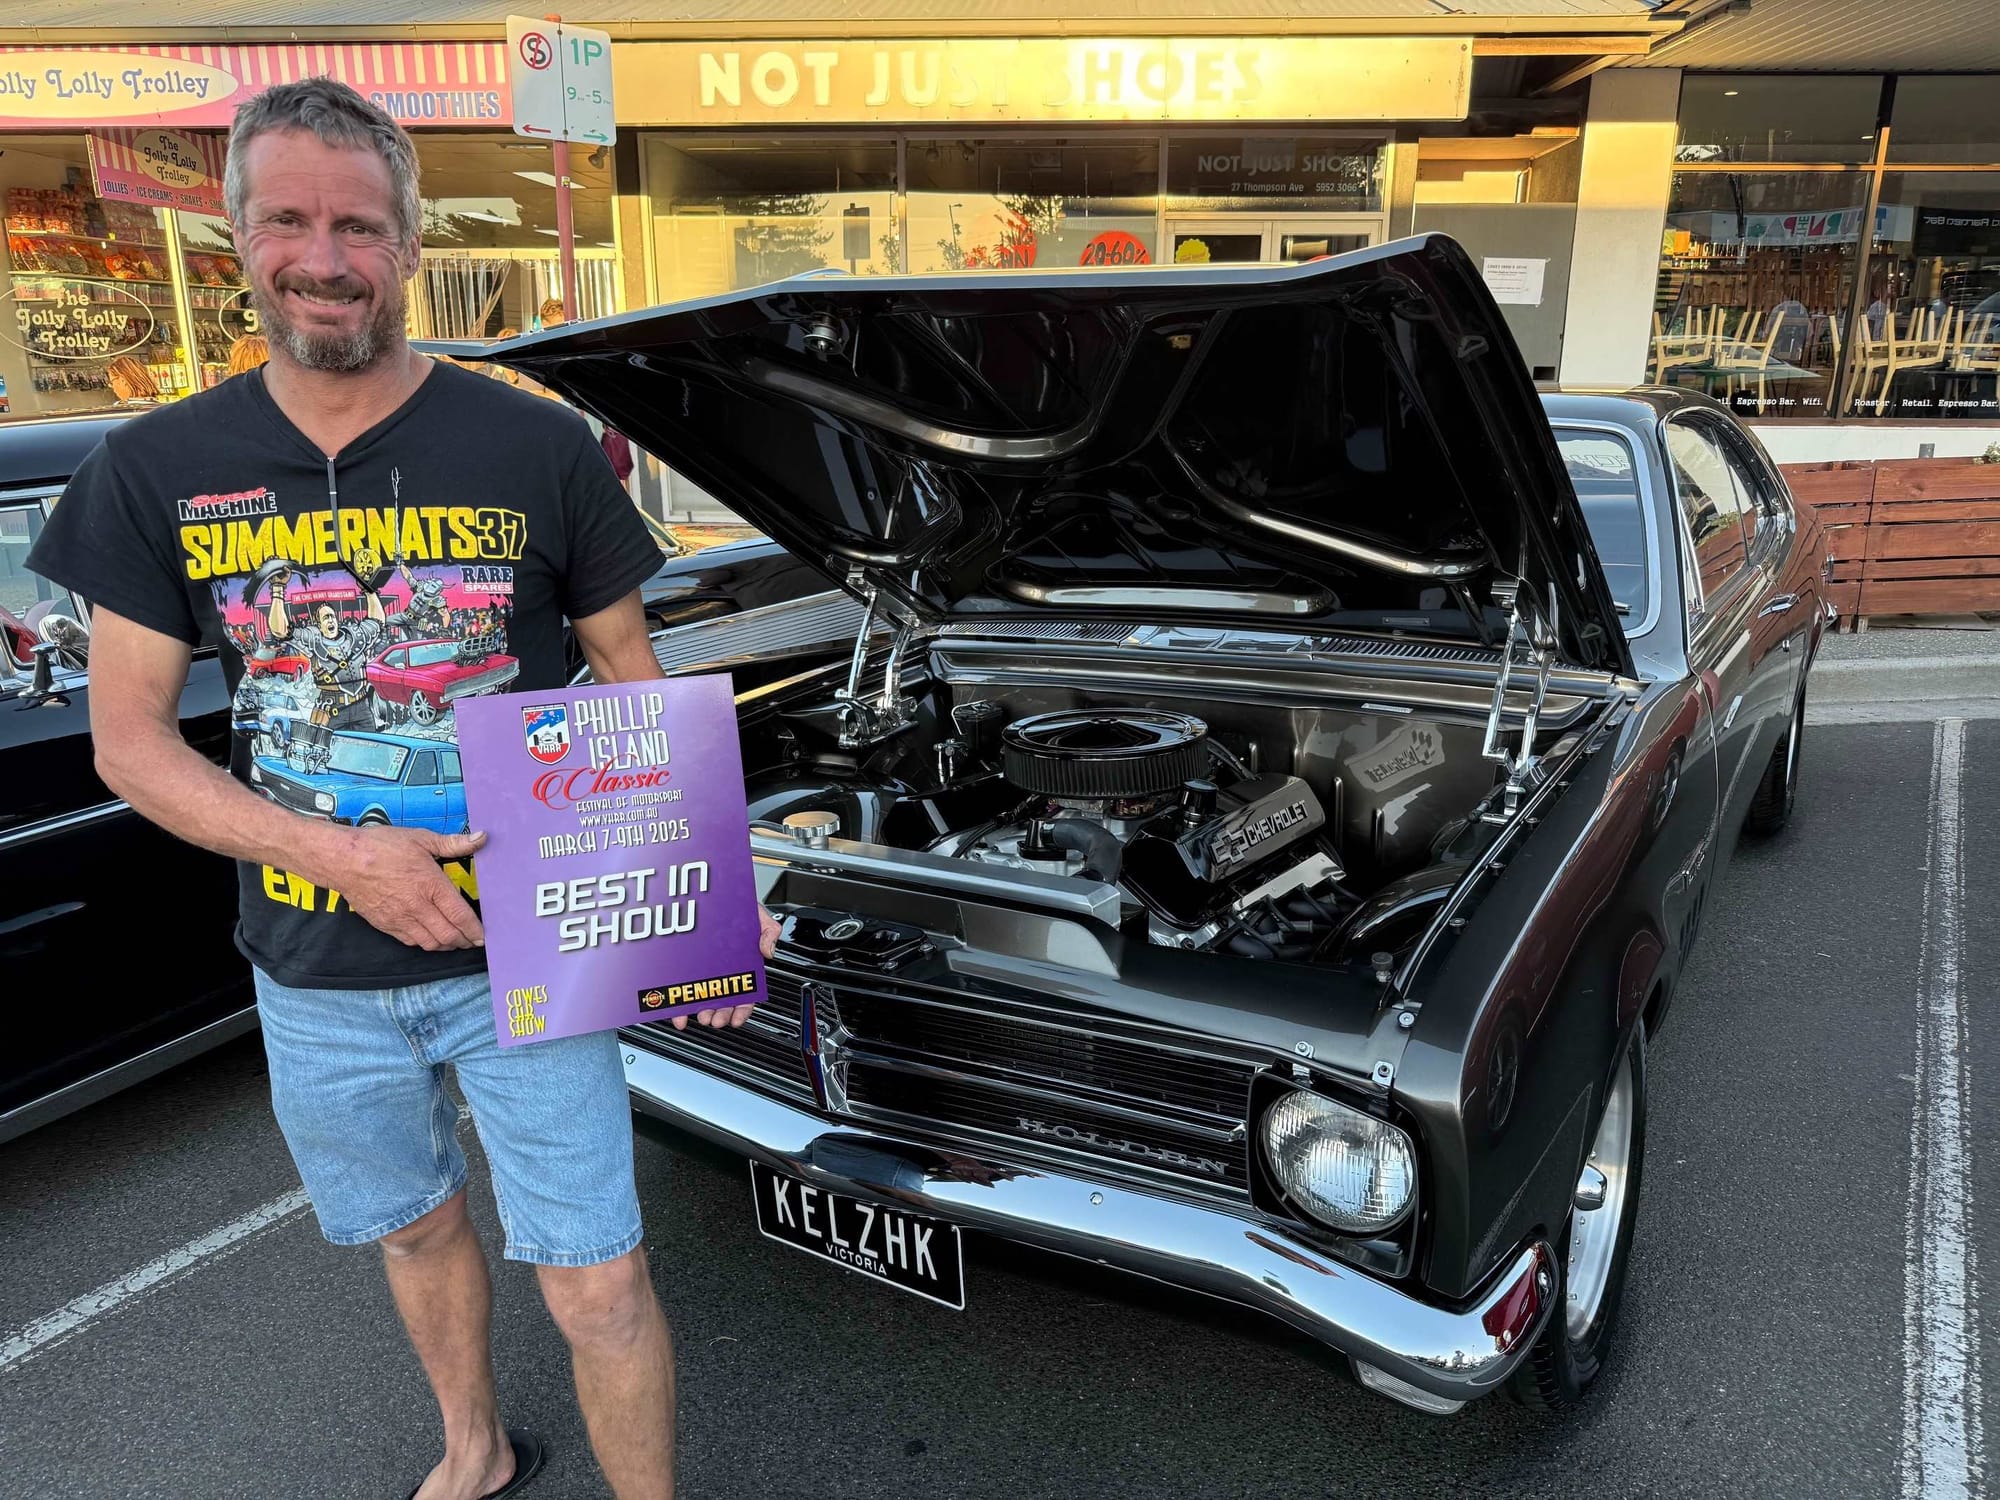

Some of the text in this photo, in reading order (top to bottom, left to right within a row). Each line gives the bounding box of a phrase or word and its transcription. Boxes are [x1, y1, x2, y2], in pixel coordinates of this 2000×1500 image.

[570, 37, 603, 67] 1P
[0, 68, 210, 100] olly Lolly Trolley
[699, 50, 1264, 108] NOT JUST SHOES
[371, 90, 501, 119] SMOOTHIES
[158, 135, 179, 152] The
[143, 146, 197, 171] Jolly Lolly
[1198, 155, 1240, 173] NOT
[1247, 156, 1293, 176] JUST
[156, 166, 190, 185] Trolley
[1231, 182, 1305, 193] 27 Thompson Ave
[1315, 182, 1334, 192] 5952
[103, 180, 129, 195] LOLLIES
[136, 186, 148, 198] ICE
[148, 187, 174, 202] CREAMS
[180, 193, 203, 208] SHAKES
[51, 287, 90, 309] The
[16, 308, 129, 332] Jolly Lolly
[40, 330, 111, 352] Trolley
[1737, 397, 1777, 407] Espresso
[1779, 397, 1798, 406] Bar.
[1854, 398, 1890, 407] Roaster
[1902, 398, 1933, 407] Retail.
[1938, 399, 1979, 408] Espresso
[177, 491, 278, 521] MACHINE
[191, 486, 267, 508] Street
[461, 565, 514, 584] RARE
[464, 583, 514, 593] SPARES
[574, 693, 665, 736] PHILLIP
[537, 744, 562, 755] VHRR
[588, 730, 671, 772] ISLAND
[532, 753, 673, 811] Classic
[576, 789, 684, 814] FESTIVAL OF MOTORSPORT
[579, 807, 659, 828] WWW.VHRR.COM.AU
[1246, 799, 1309, 846] CHEVROLET
[539, 818, 691, 859] MARCH 7-9TH 2025
[536, 861, 709, 917] BEST IN
[558, 899, 696, 952] SHOW
[506, 984, 548, 1008] COWES
[668, 973, 754, 1005] PENRITE
[510, 1015, 545, 1038] SHOW
[1016, 1116, 1229, 1175] HOLDEN
[772, 1175, 938, 1282] KELZHK
[825, 1242, 887, 1276] VICTORIA
